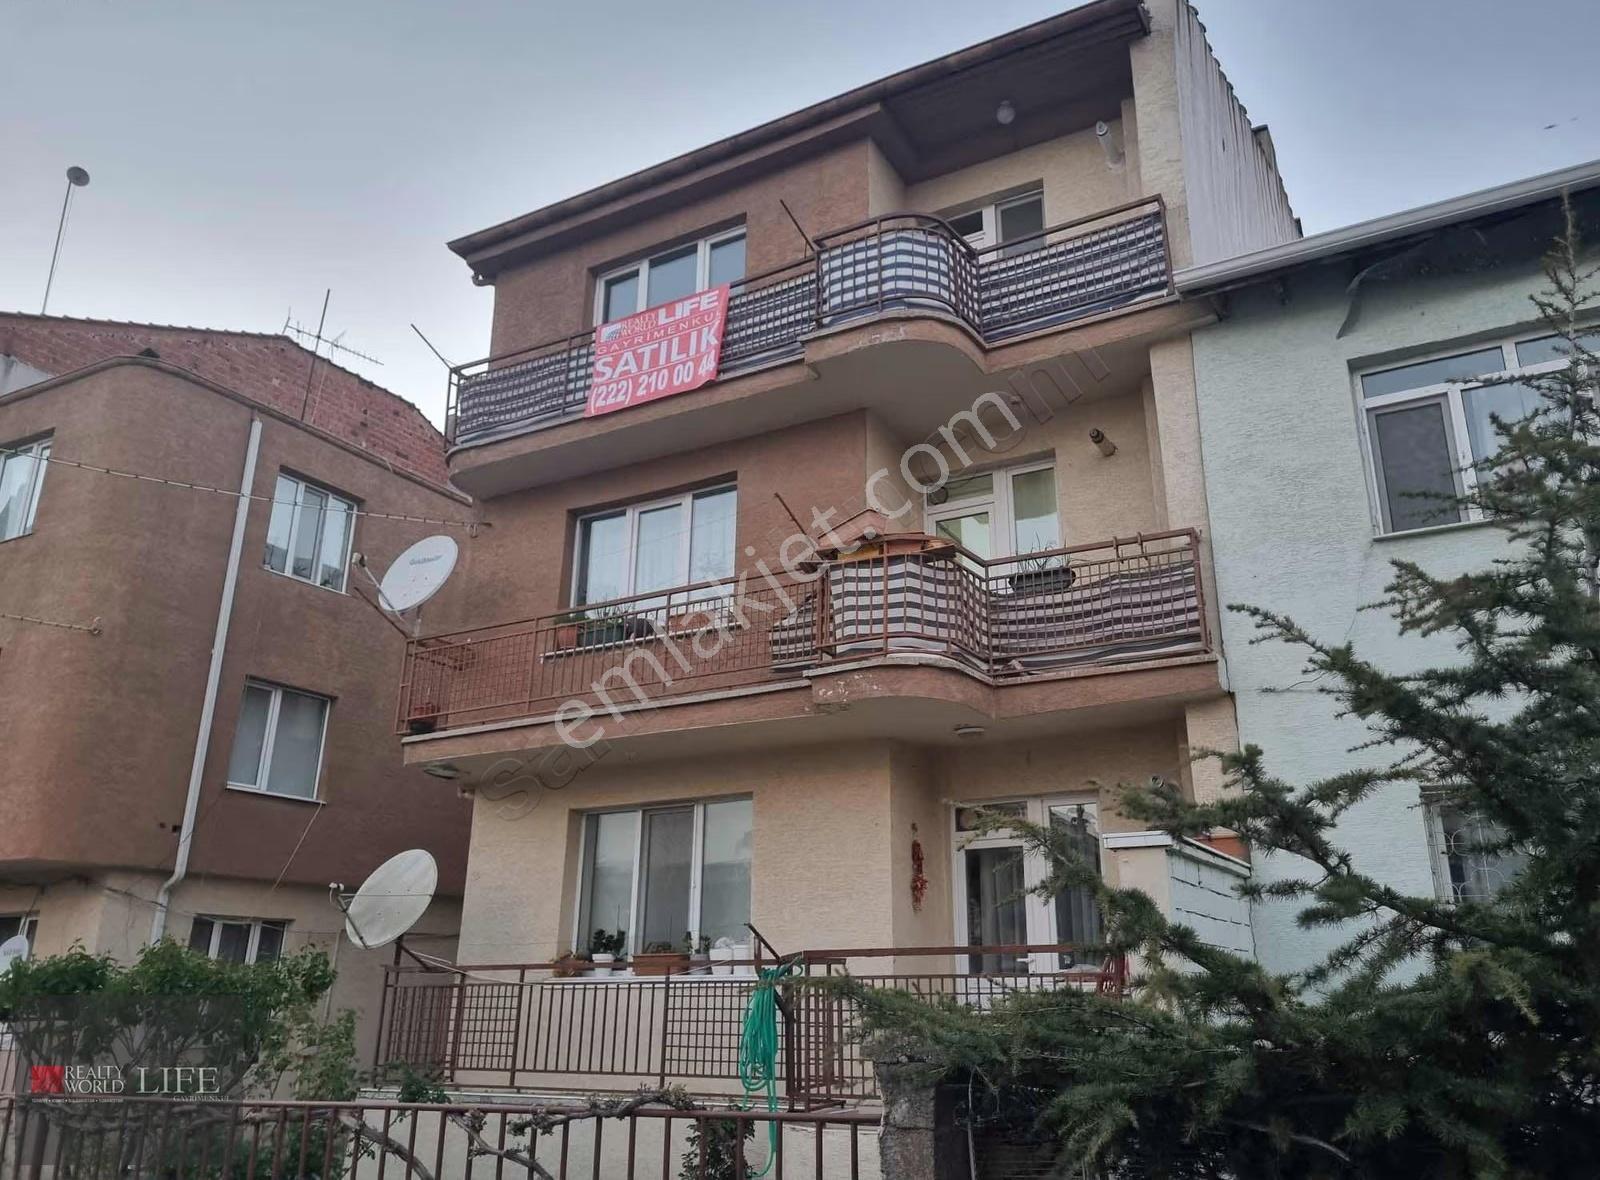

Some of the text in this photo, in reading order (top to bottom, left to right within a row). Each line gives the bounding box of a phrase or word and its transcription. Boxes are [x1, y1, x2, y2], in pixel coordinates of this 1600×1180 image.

[658, 290, 719, 325] LIFE
[594, 320, 720, 382] SATILIK
[591, 378, 632, 414] (222)
[637, 368, 668, 396] 210
[673, 361, 694, 386] 00
